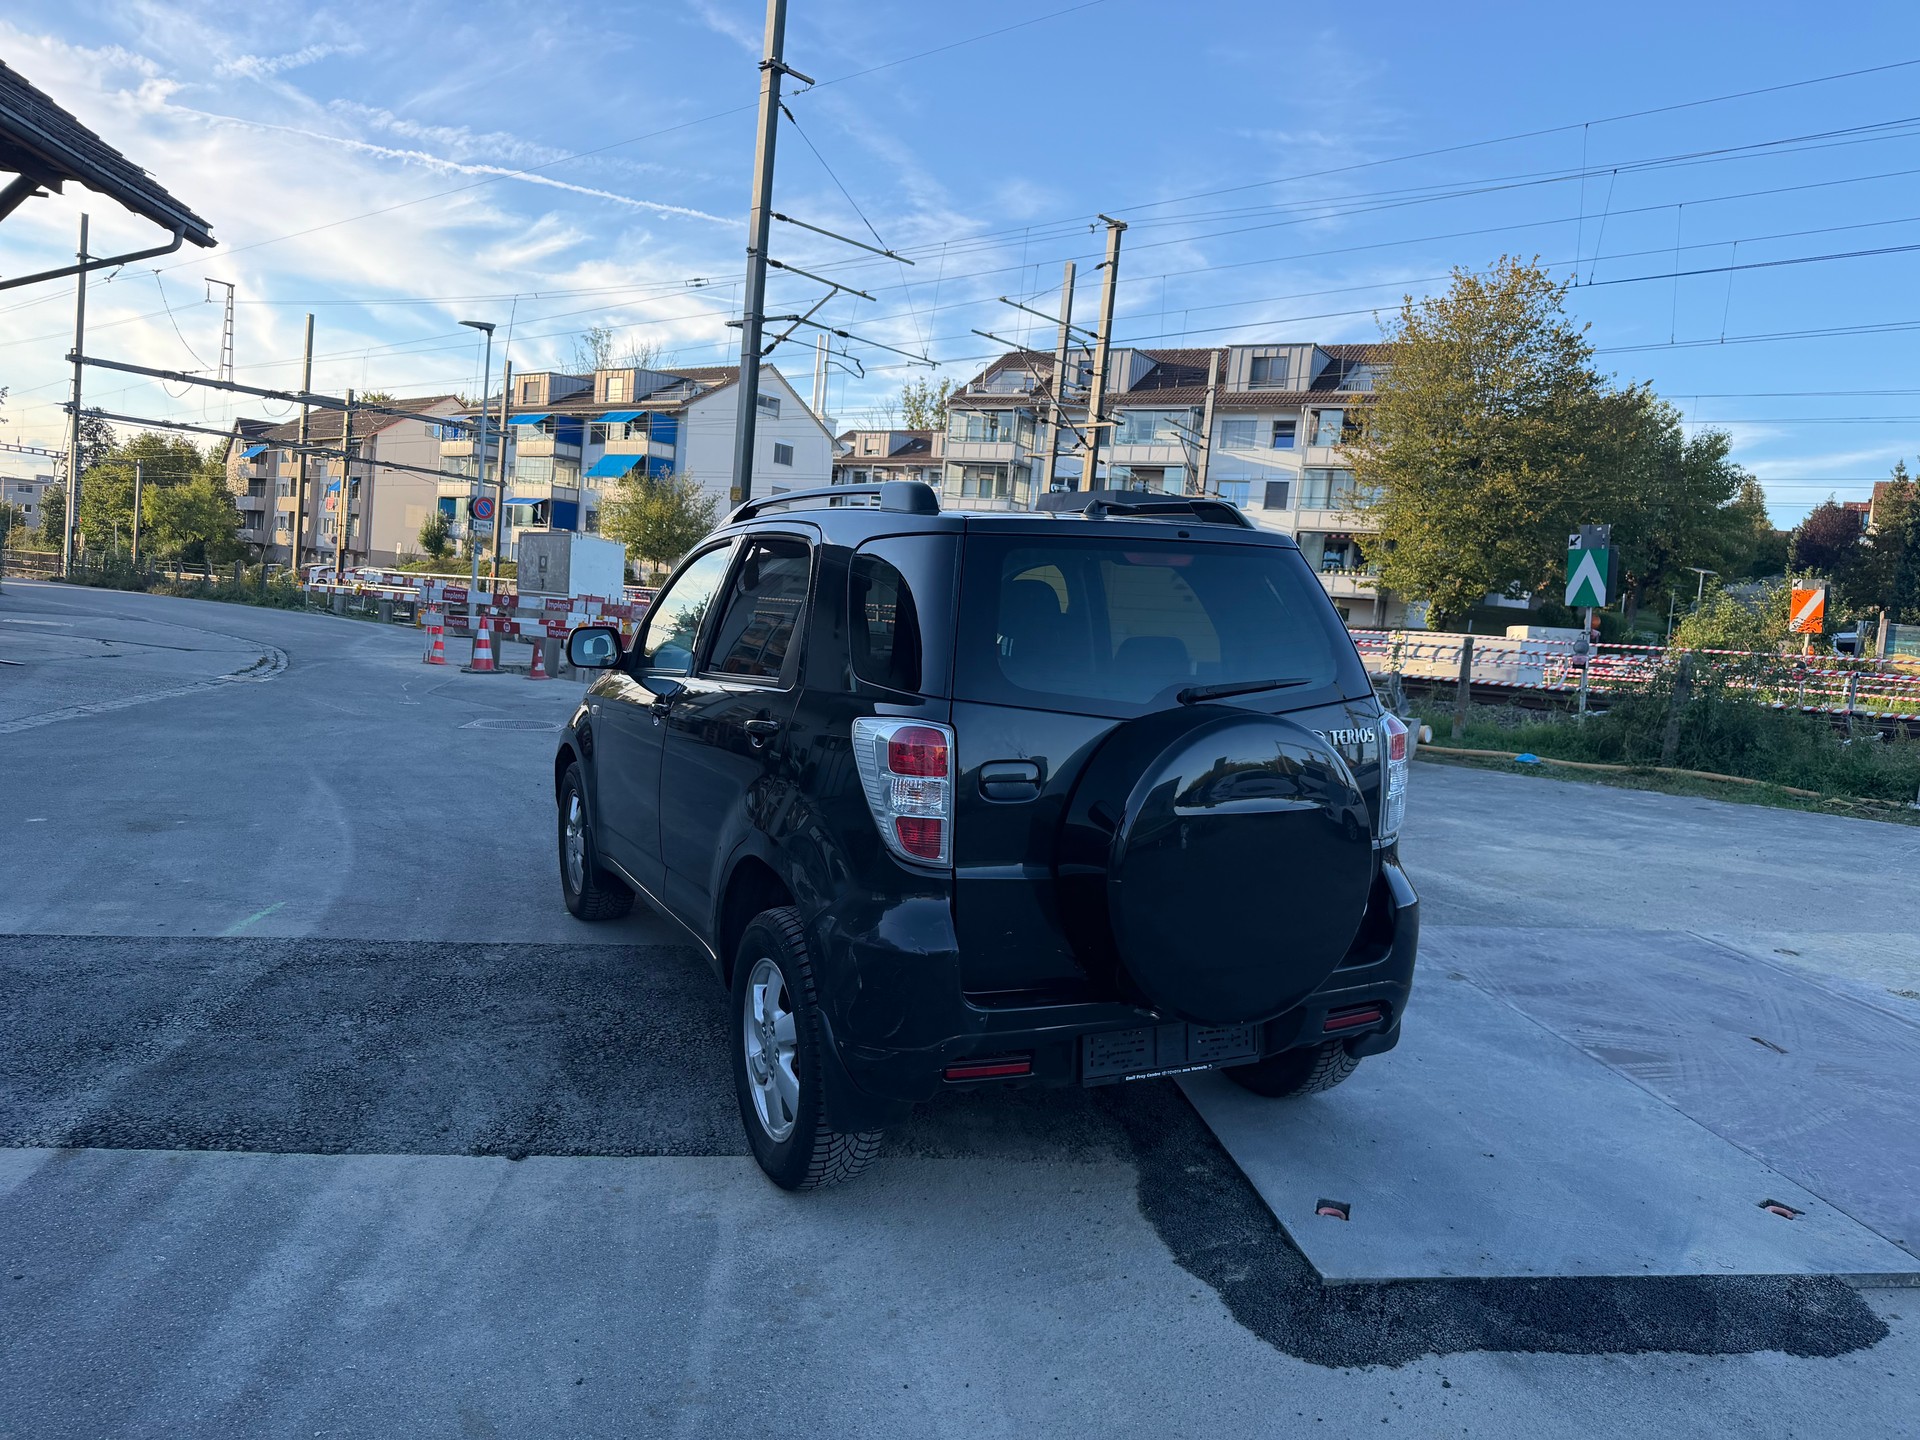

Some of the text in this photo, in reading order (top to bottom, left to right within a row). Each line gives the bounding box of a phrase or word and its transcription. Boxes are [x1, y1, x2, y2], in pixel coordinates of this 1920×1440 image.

[444, 591, 466, 600] Implenia
[547, 599, 571, 611] Implenia
[446, 618, 467, 627] Implenia
[548, 628, 570, 637] Impleni
[1328, 727, 1375, 746] TERIOS
